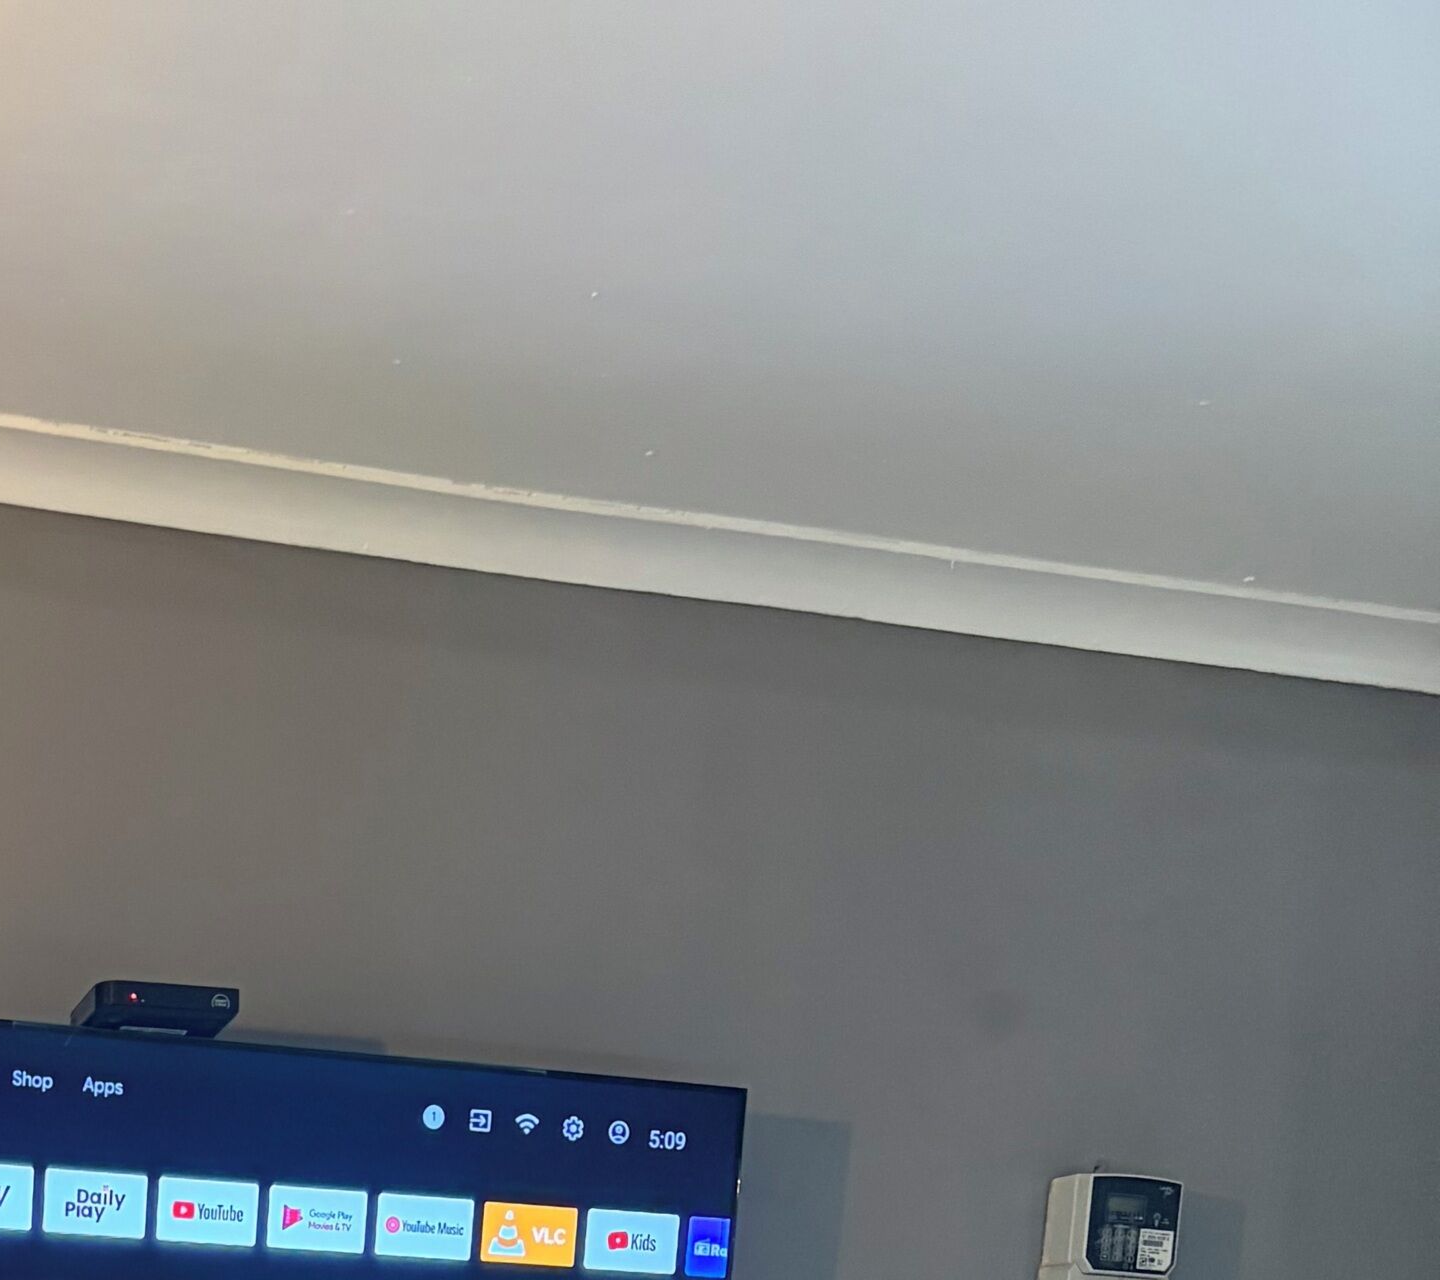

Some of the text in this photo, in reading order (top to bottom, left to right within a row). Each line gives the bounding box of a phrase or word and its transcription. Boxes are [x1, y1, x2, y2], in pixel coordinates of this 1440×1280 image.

[12, 1070, 54, 1092] Shop
[83, 1076, 125, 1098] Apps
[648, 1129, 687, 1151] 5:09
[76, 1187, 126, 1211] Daily
[65, 1201, 106, 1222] Play
[197, 1202, 244, 1224] YouTube
[309, 1208, 353, 1223] Google Play
[308, 1221, 335, 1232] Movies
[341, 1223, 353, 1232] TV
[402, 1220, 464, 1236] YouTube Music
[532, 1226, 567, 1247] VLC
[630, 1231, 657, 1253] Kids
